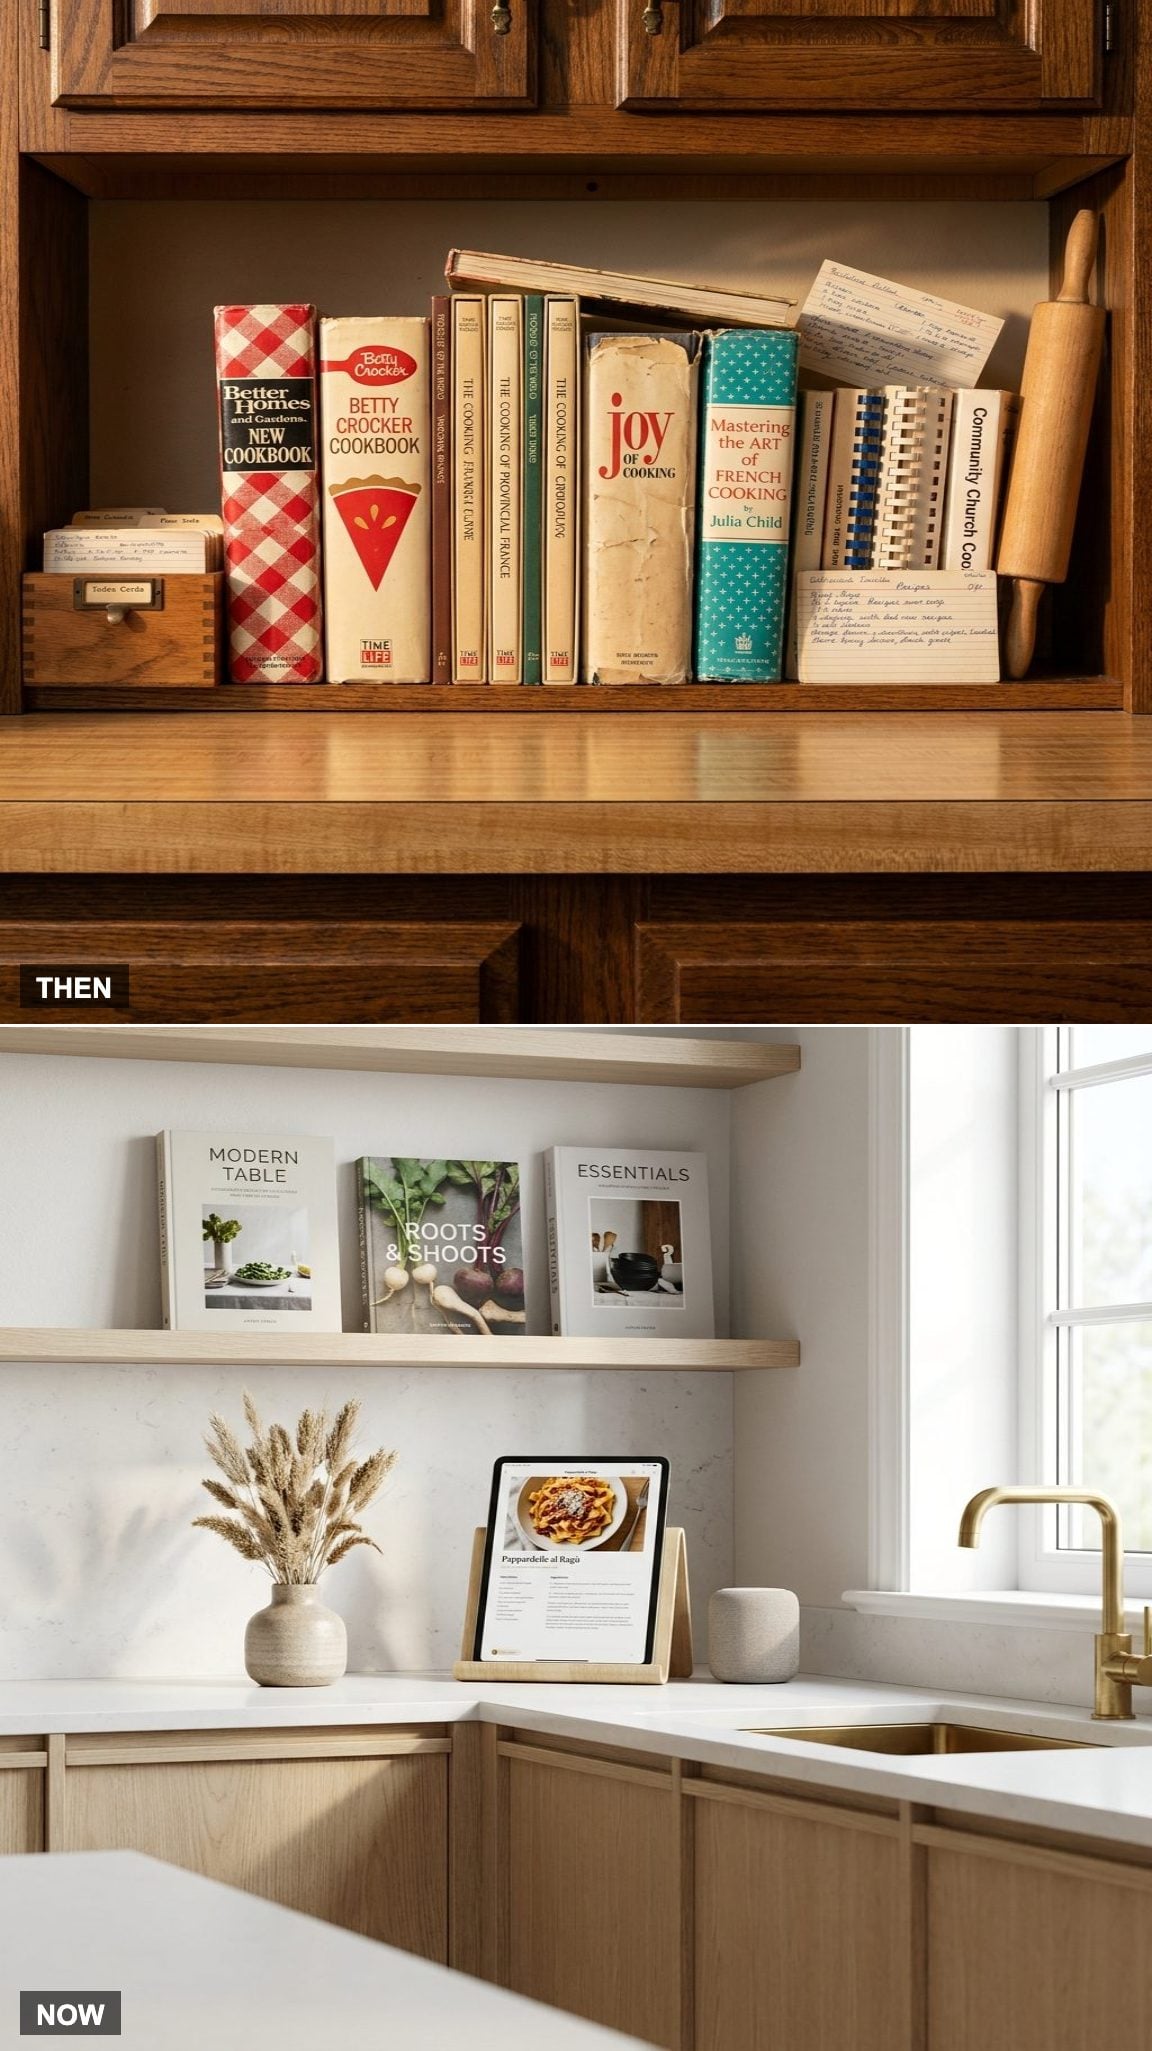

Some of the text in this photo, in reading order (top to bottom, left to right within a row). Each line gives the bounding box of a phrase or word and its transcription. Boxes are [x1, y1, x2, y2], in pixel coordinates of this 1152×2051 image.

[360, 352, 398, 366] Betty
[354, 363, 409, 377] Crocker
[223, 386, 289, 400] Better
[463, 378, 474, 399] THE
[500, 377, 511, 398] THE
[556, 378, 567, 399] THE
[234, 399, 311, 414] Homes
[349, 397, 399, 414] BETTY
[231, 415, 253, 424] and
[336, 417, 413, 434] CROCKER
[500, 402, 511, 451] COOKING
[555, 402, 567, 452] COOKING
[248, 427, 286, 445] NEW
[463, 403, 475, 455] COOKING
[598, 392, 675, 480] joy
[711, 419, 791, 438] Mastering
[329, 437, 420, 455] COOKBOOK
[719, 436, 782, 450] the ART
[965, 407, 988, 486] Community
[224, 446, 313, 465] COOKBOOK
[499, 455, 511, 469] OF
[555, 455, 567, 469] OF
[623, 453, 639, 465] OF
[741, 453, 760, 466] of
[623, 467, 676, 479] COOKING
[716, 470, 782, 484] FRENCH
[708, 487, 788, 501] COOKING
[744, 505, 753, 513] by
[963, 489, 981, 539] Church
[710, 515, 783, 529] Julia Child
[499, 537, 511, 579] FRANCE
[961, 542, 977, 570] Coo
[362, 641, 390, 650] TIME
[362, 651, 390, 663] LIFE
[209, 1147, 299, 1165] MODERN
[222, 1166, 287, 1183] TABLE
[577, 1163, 690, 1182] ESSENTIALS
[404, 1222, 487, 1241] ROOTS
[386, 1243, 507, 1264] & SHOOTS
[550, 1555, 558, 1563] al
